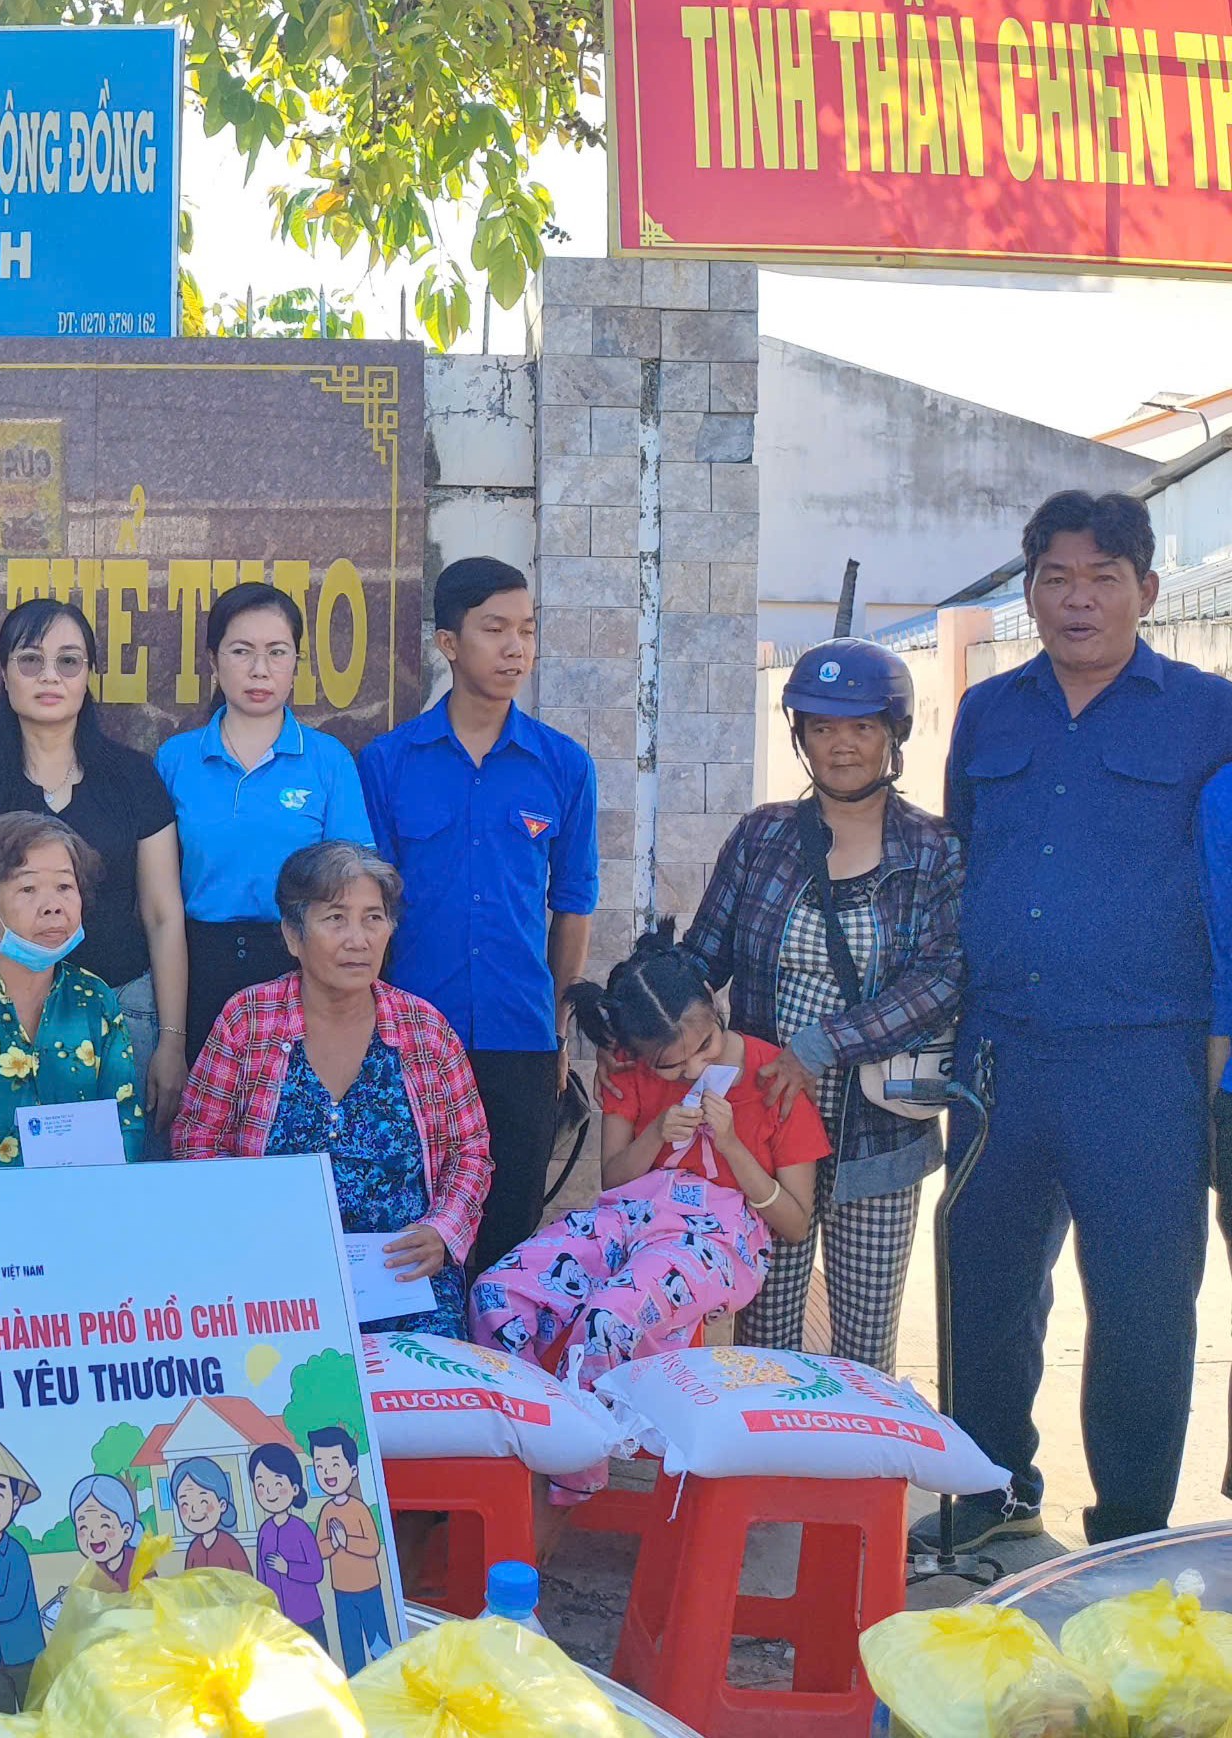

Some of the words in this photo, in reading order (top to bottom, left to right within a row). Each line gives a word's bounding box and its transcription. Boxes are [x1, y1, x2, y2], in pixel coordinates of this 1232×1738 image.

[681, 5, 819, 170] TINH
[68, 78, 157, 194] ĐỒNG
[57, 311, 78, 334] ĐT:
[80, 312, 106, 334] 0270
[109, 312, 134, 334] 3780
[137, 312, 156, 334] 162
[23, 1265, 44, 1277] NAM
[79, 1297, 137, 1346] PHỐ
[144, 1294, 182, 1342] HỒ
[190, 1295, 239, 1339] CHÍ
[244, 1298, 320, 1335] MINH
[13, 1359, 80, 1408] YÊU
[88, 1356, 224, 1403] THƯƠNG
[380, 1392, 481, 1410] HƯƠNG
[772, 1412, 872, 1433] HƯƠNG
[879, 1419, 922, 1443] LÀI
